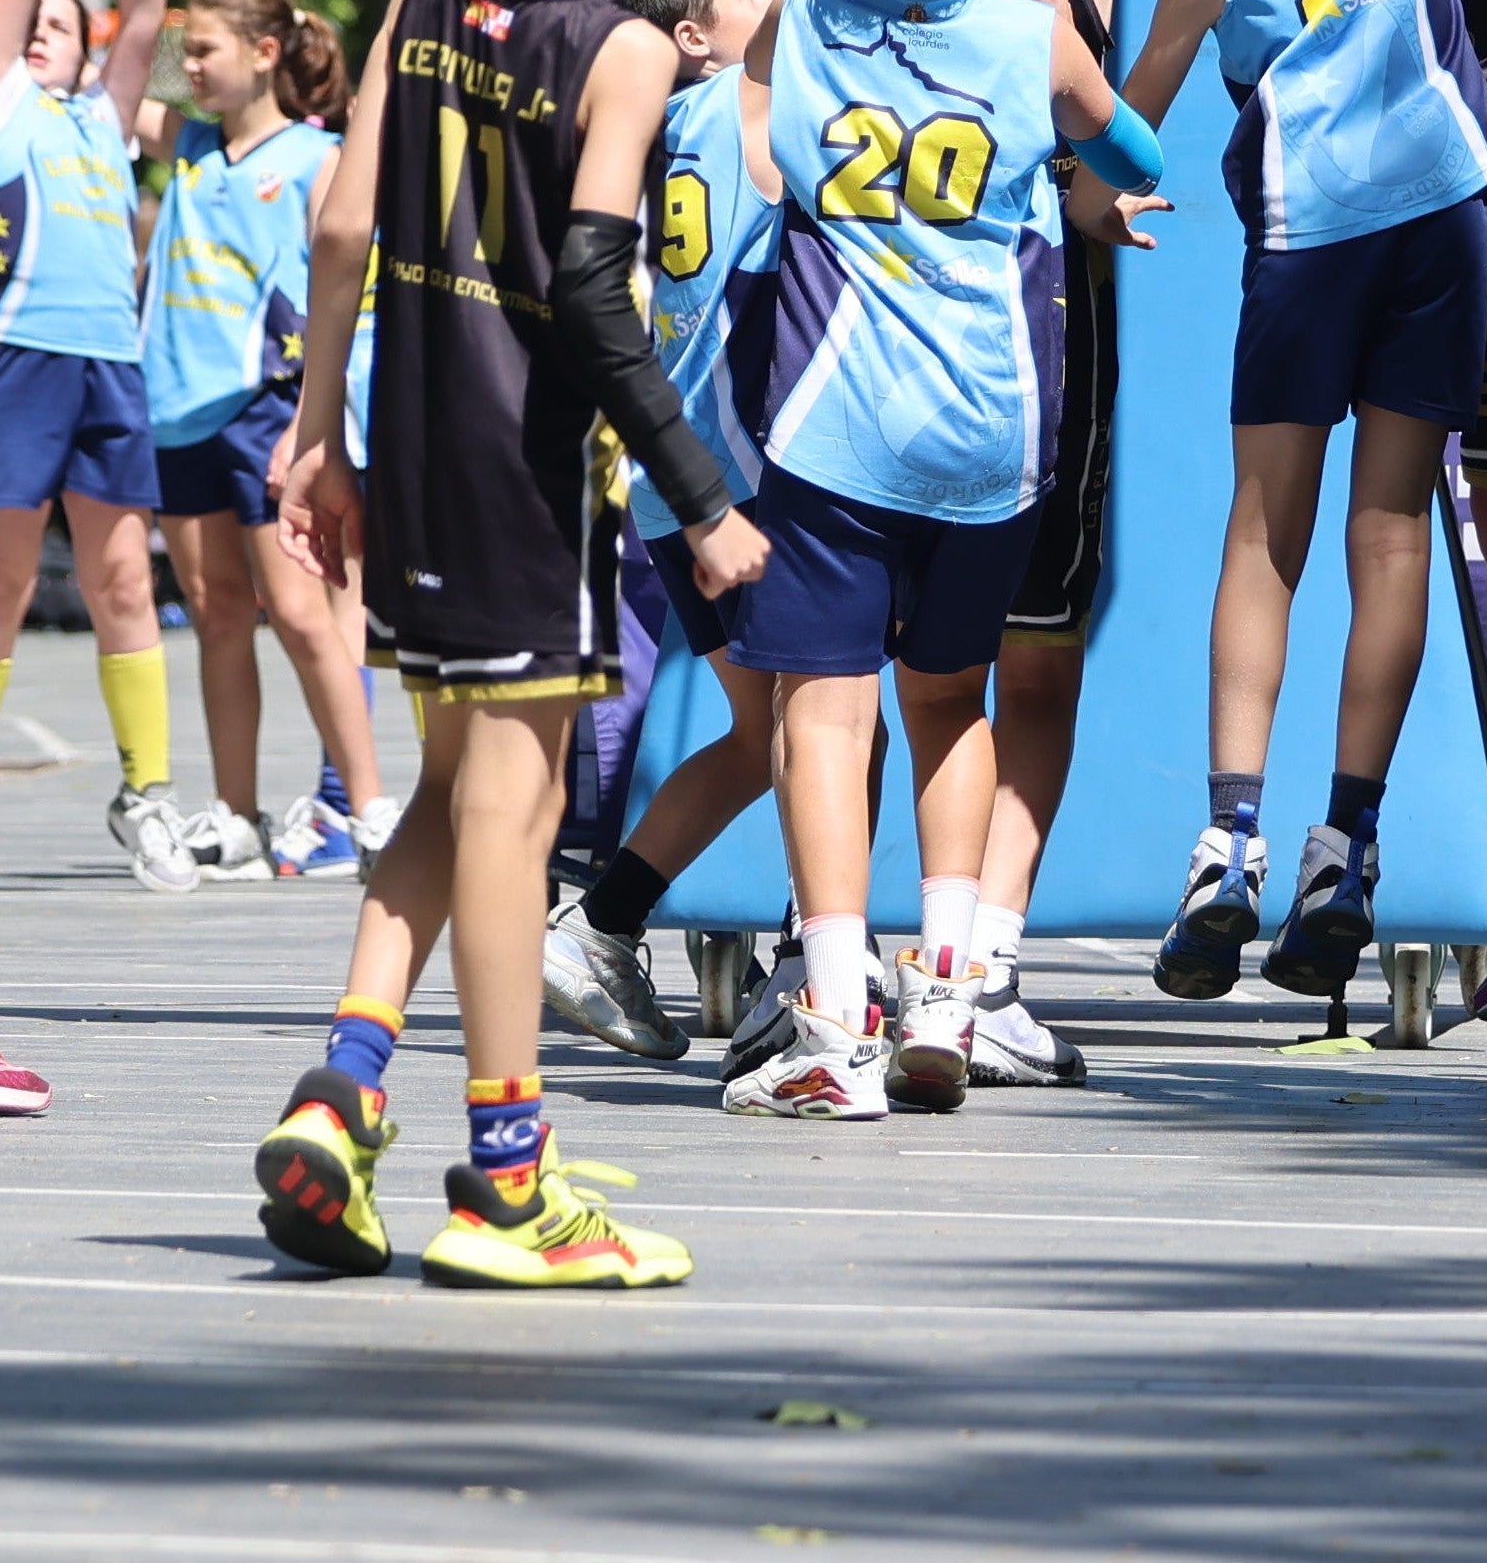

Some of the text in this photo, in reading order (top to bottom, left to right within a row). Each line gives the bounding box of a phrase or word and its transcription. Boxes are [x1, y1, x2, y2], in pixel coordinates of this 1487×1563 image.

[902, 25, 943, 40] colegio
[908, 37, 950, 51] lourdes
[814, 100, 999, 227] 20
[927, 984, 956, 997] NIKE
[855, 1044, 879, 1058] NIKE
